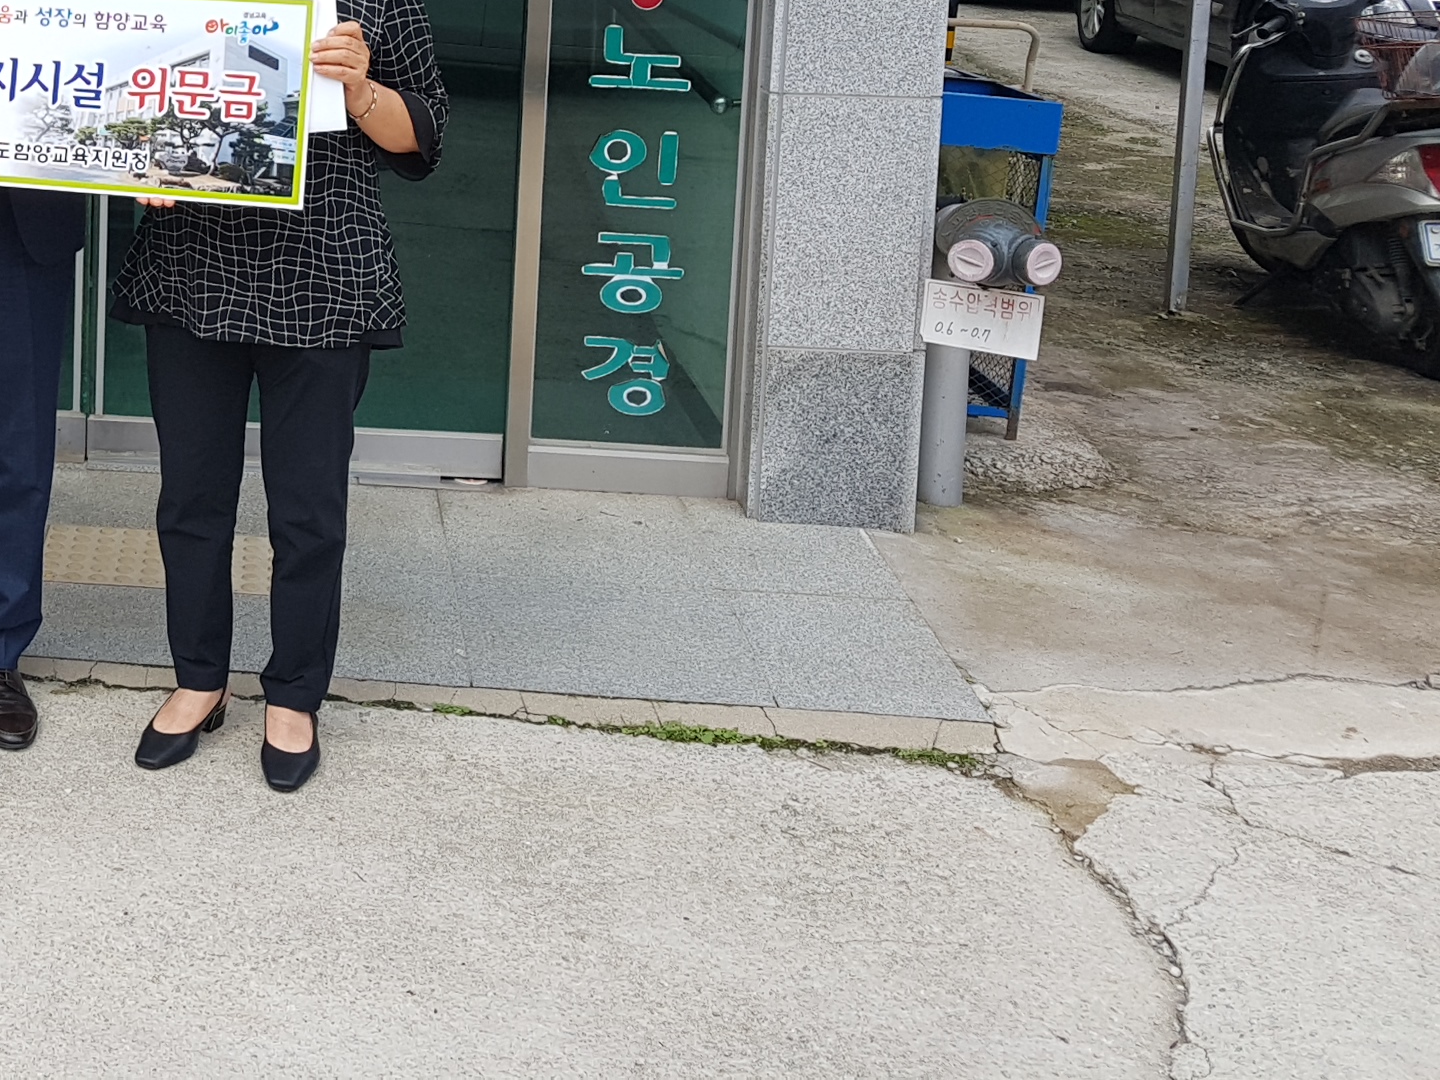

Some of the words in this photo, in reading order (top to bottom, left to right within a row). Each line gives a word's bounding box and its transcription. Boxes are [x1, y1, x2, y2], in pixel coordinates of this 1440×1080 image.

[34, 6, 87, 28] 성장의
[94, 10, 168, 33] 함양교육
[205, 17, 280, 45] 아이좋아
[126, 66, 263, 121] 위문금
